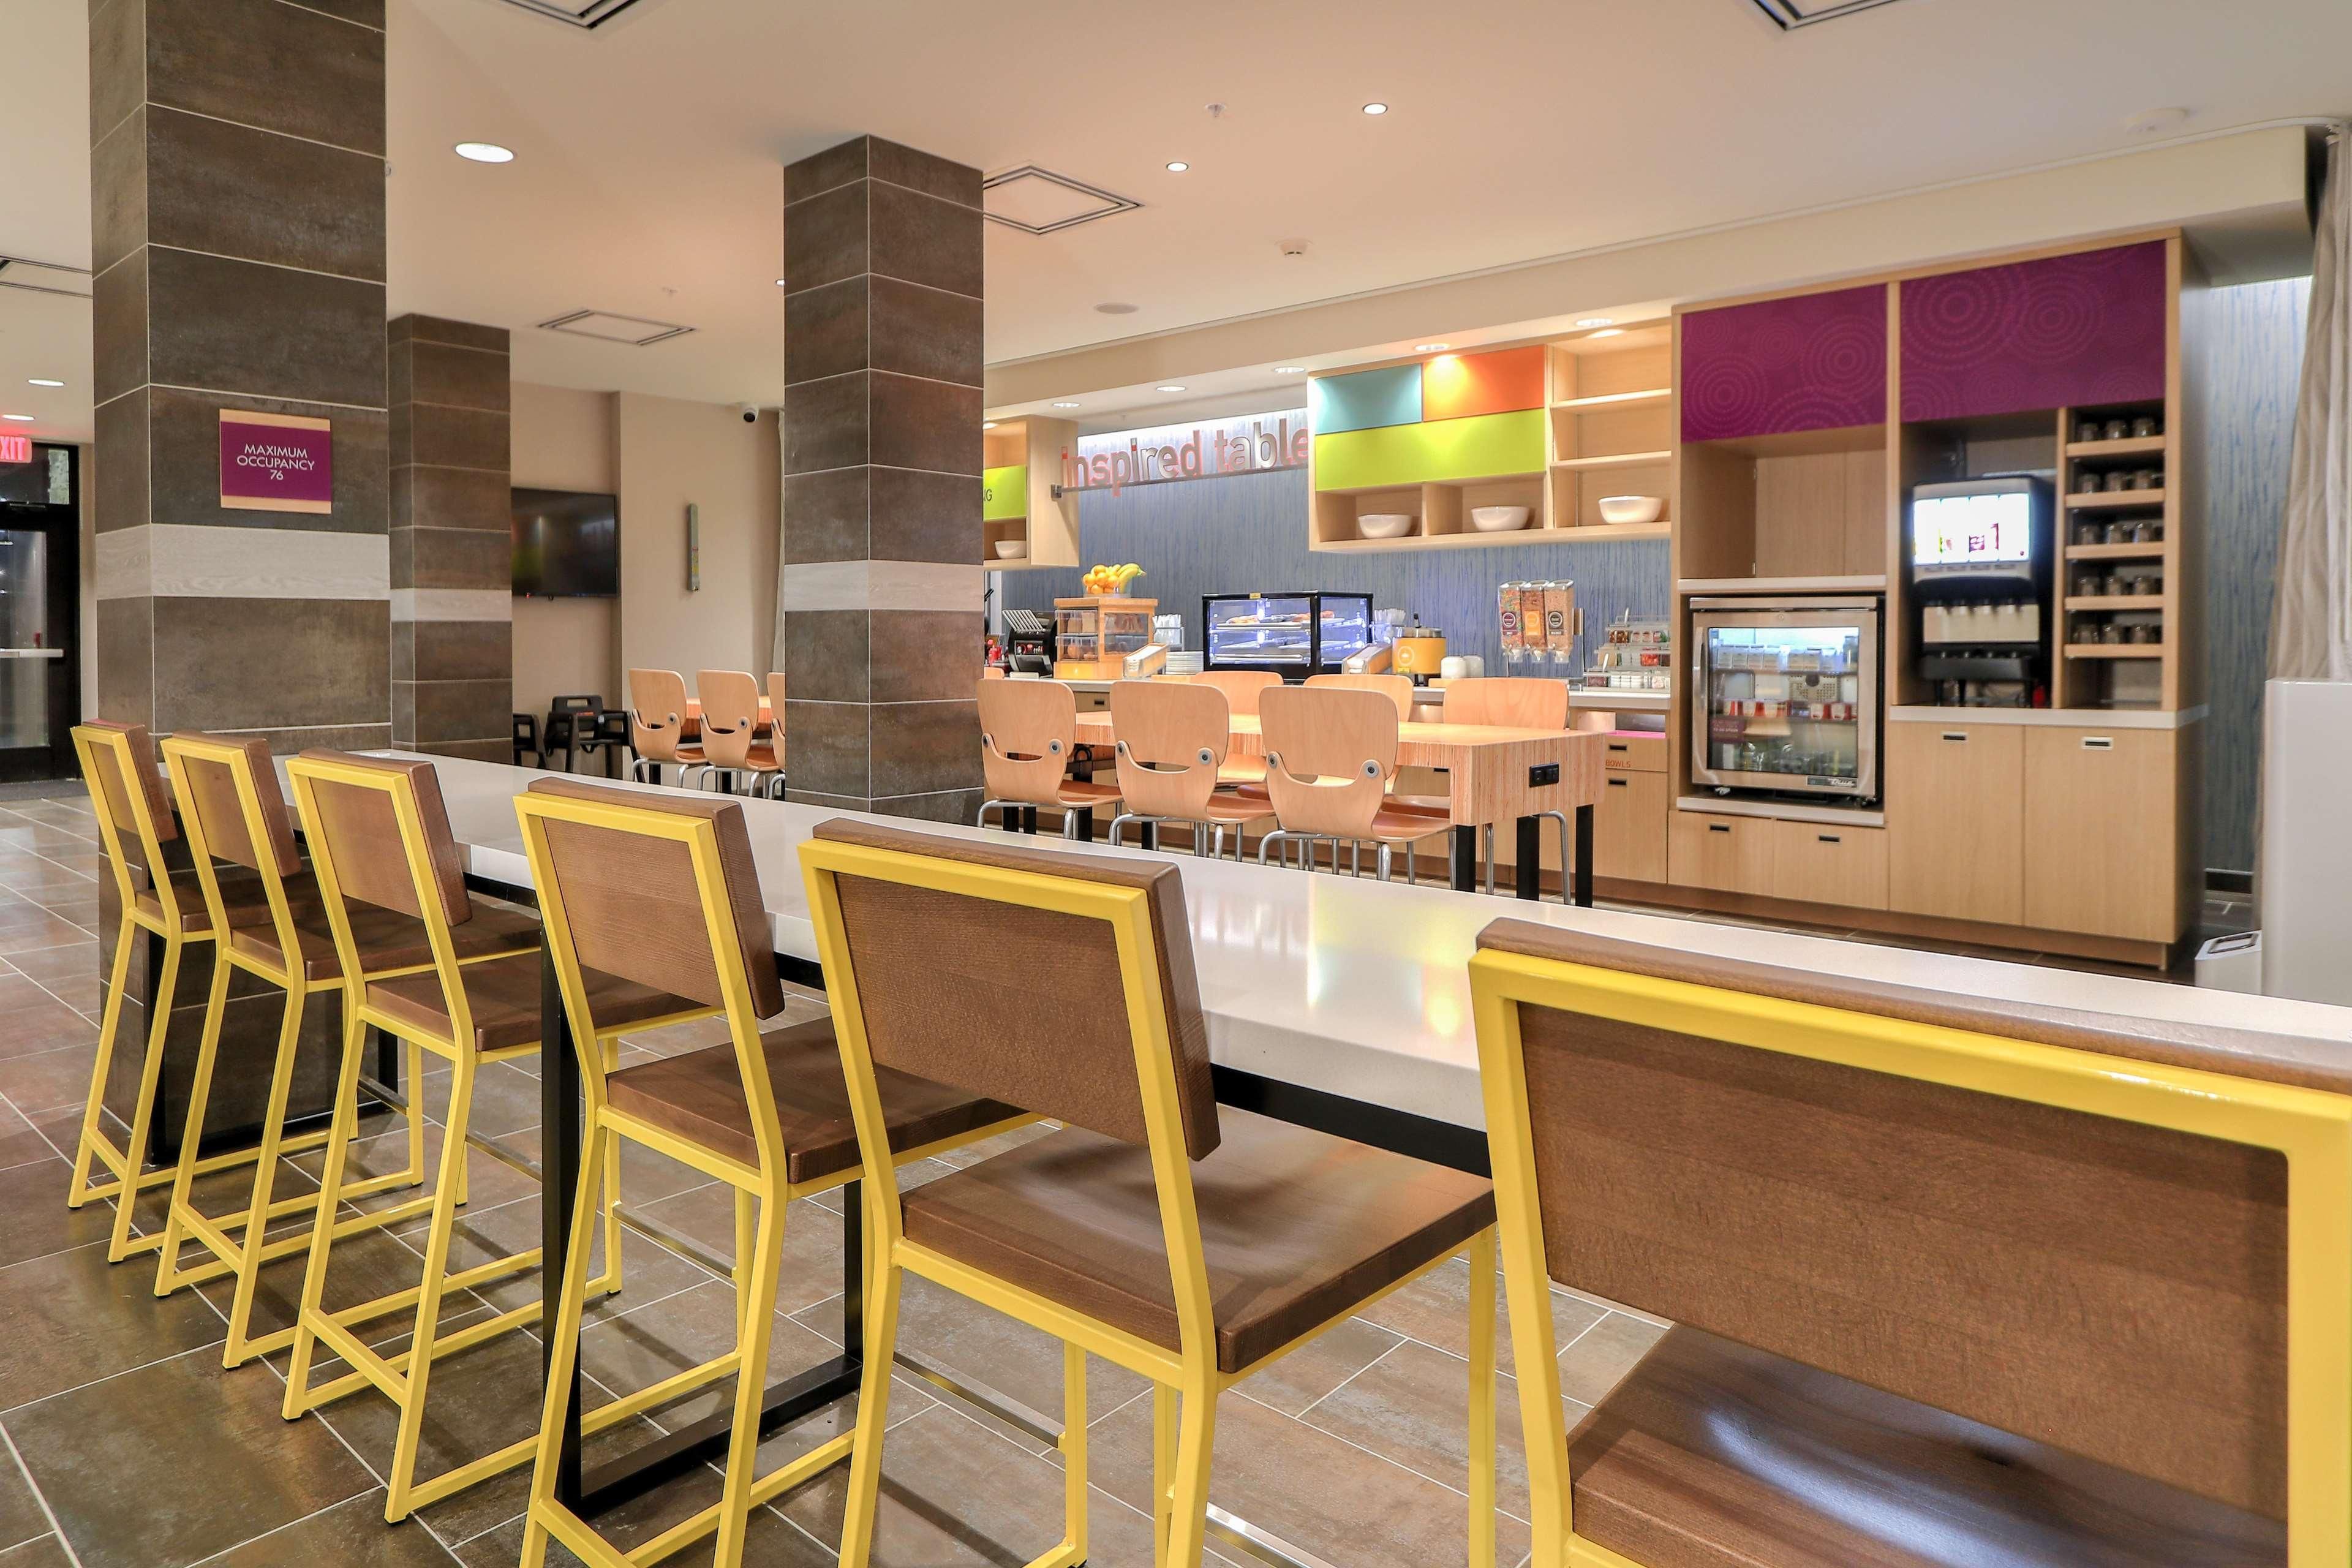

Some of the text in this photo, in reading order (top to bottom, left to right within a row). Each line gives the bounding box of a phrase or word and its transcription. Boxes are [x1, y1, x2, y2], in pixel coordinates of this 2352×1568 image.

[0, 435, 26, 461] XIT
[244, 443, 308, 459] MAXIMUM
[236, 455, 315, 471] OCCUPANCY
[1060, 418, 1309, 498] inspired table
[270, 470, 284, 481] 76
